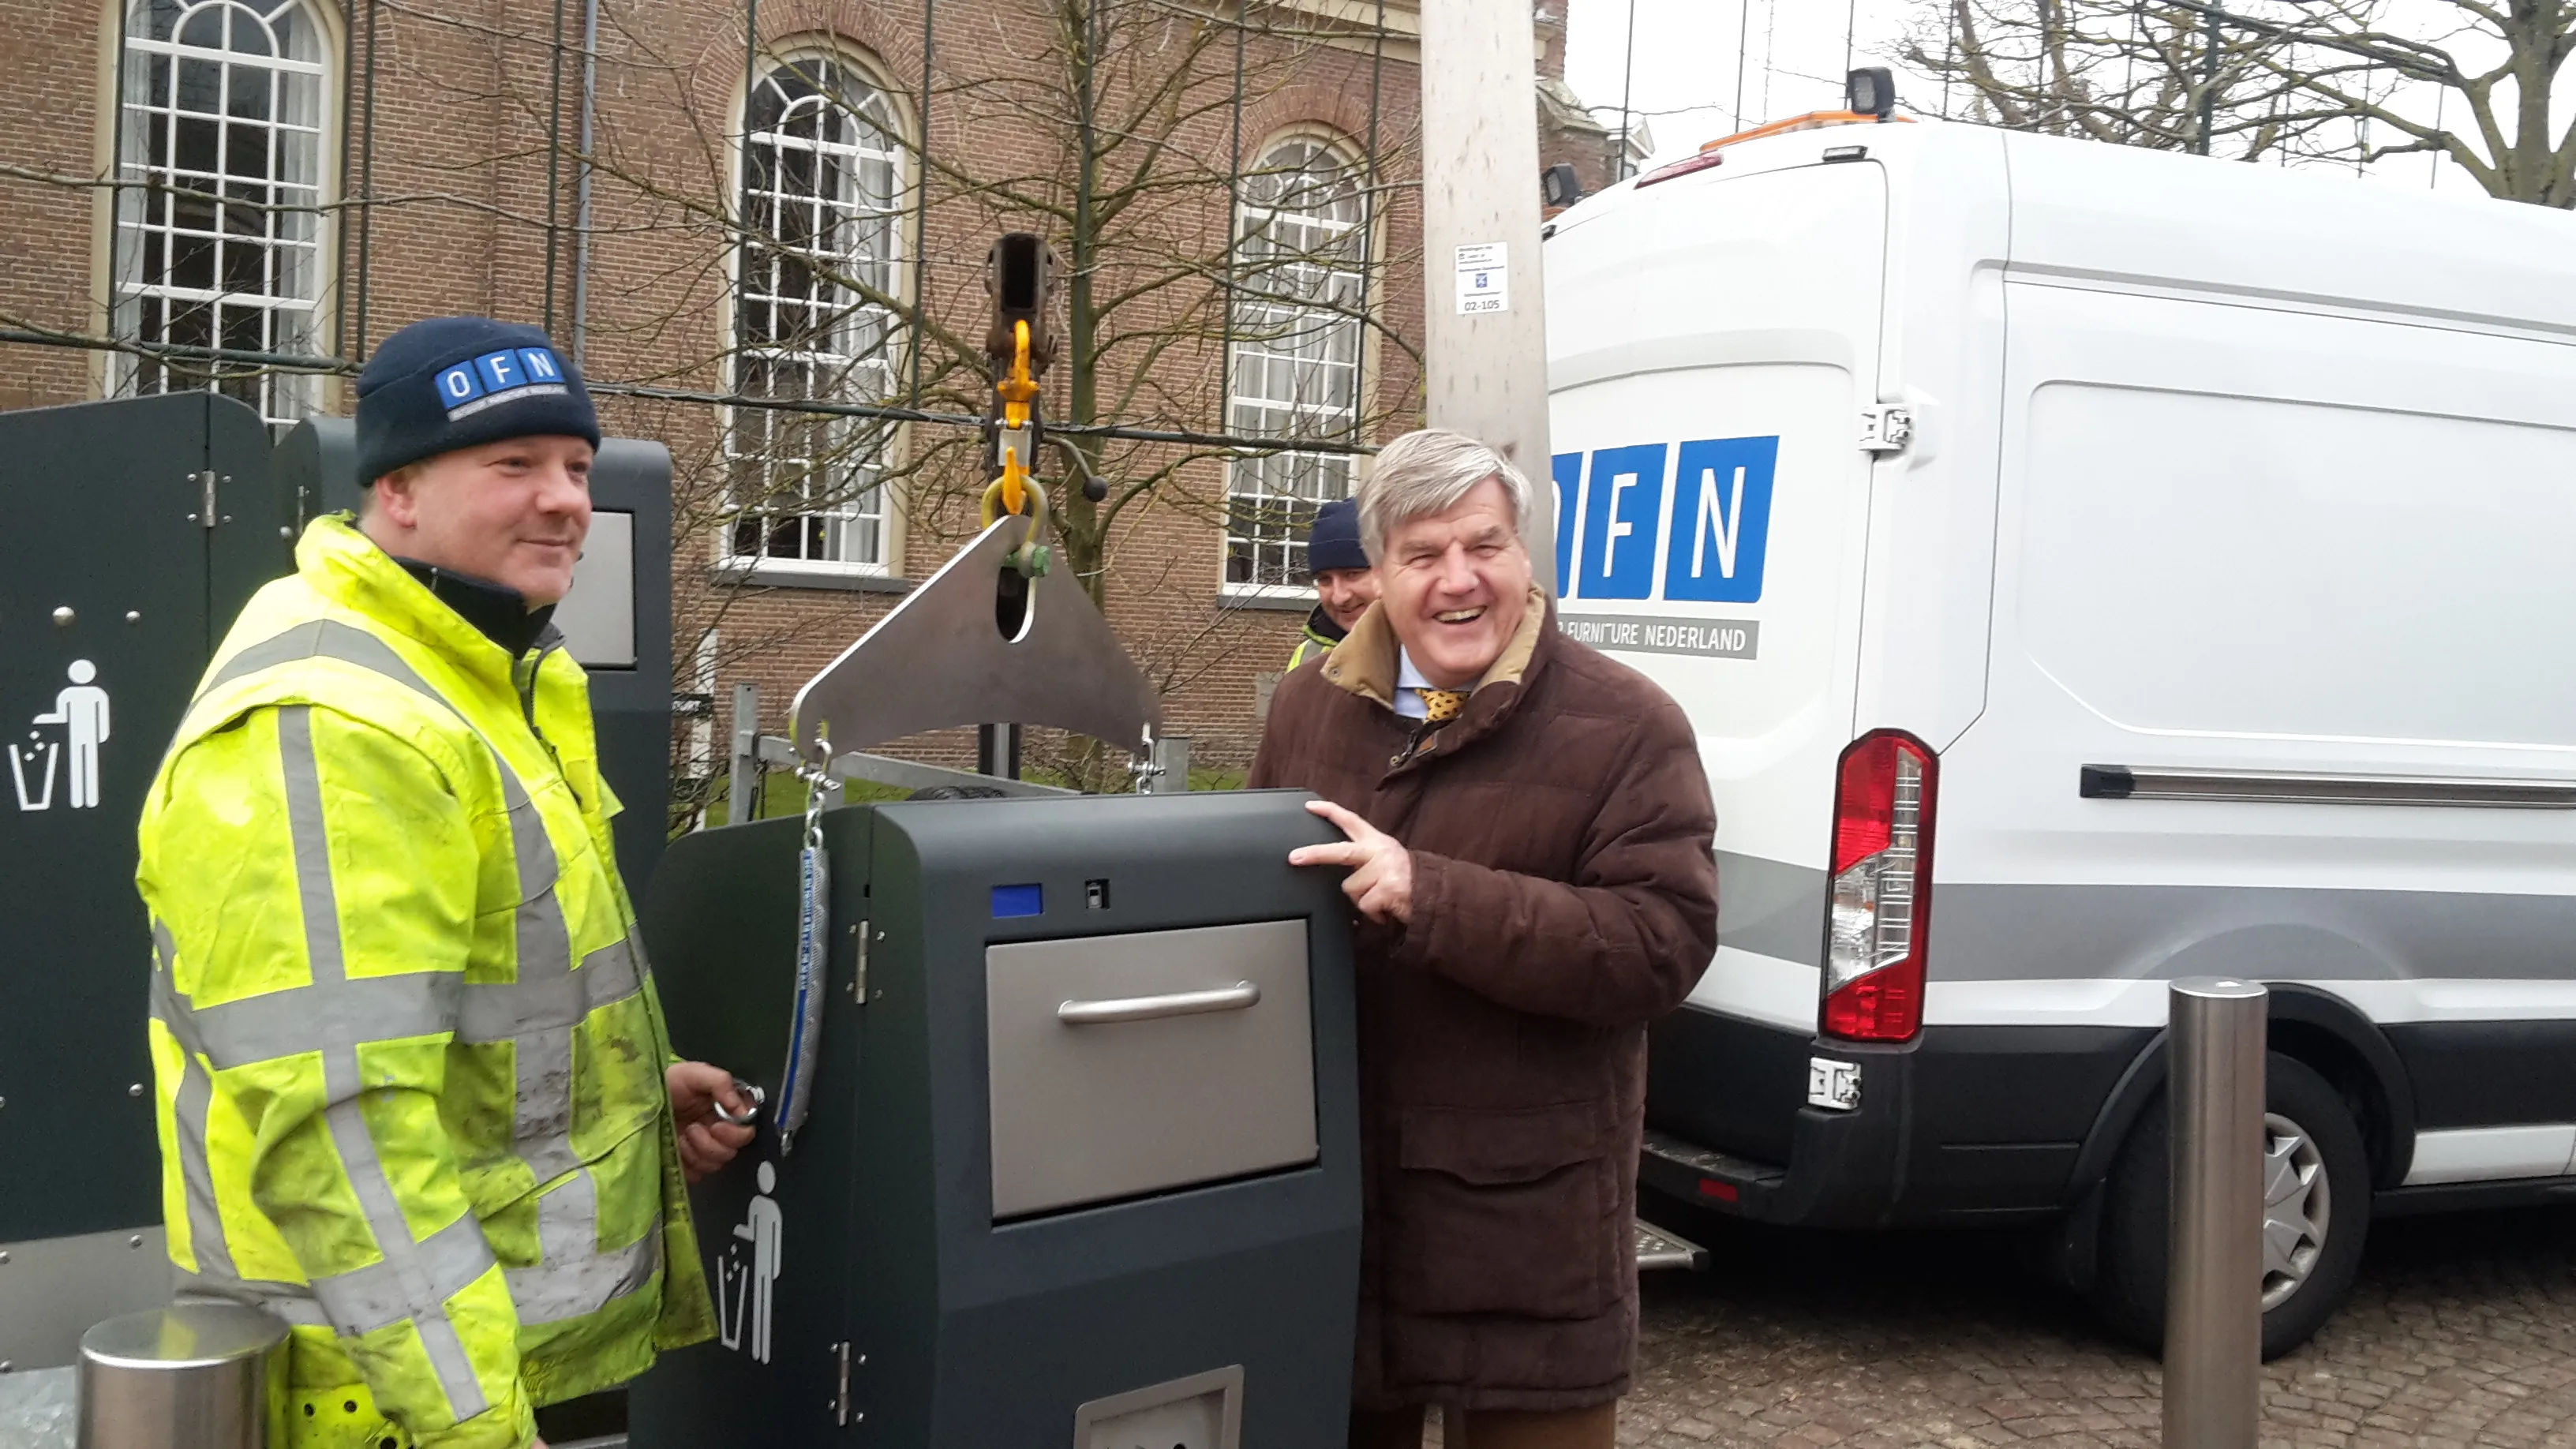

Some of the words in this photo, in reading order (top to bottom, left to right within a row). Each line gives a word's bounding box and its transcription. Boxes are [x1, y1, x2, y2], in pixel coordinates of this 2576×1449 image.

[1464, 300, 1500, 311] 02-105
[447, 353, 556, 398] OFN
[1644, 624, 1747, 651] NEDERLAND
